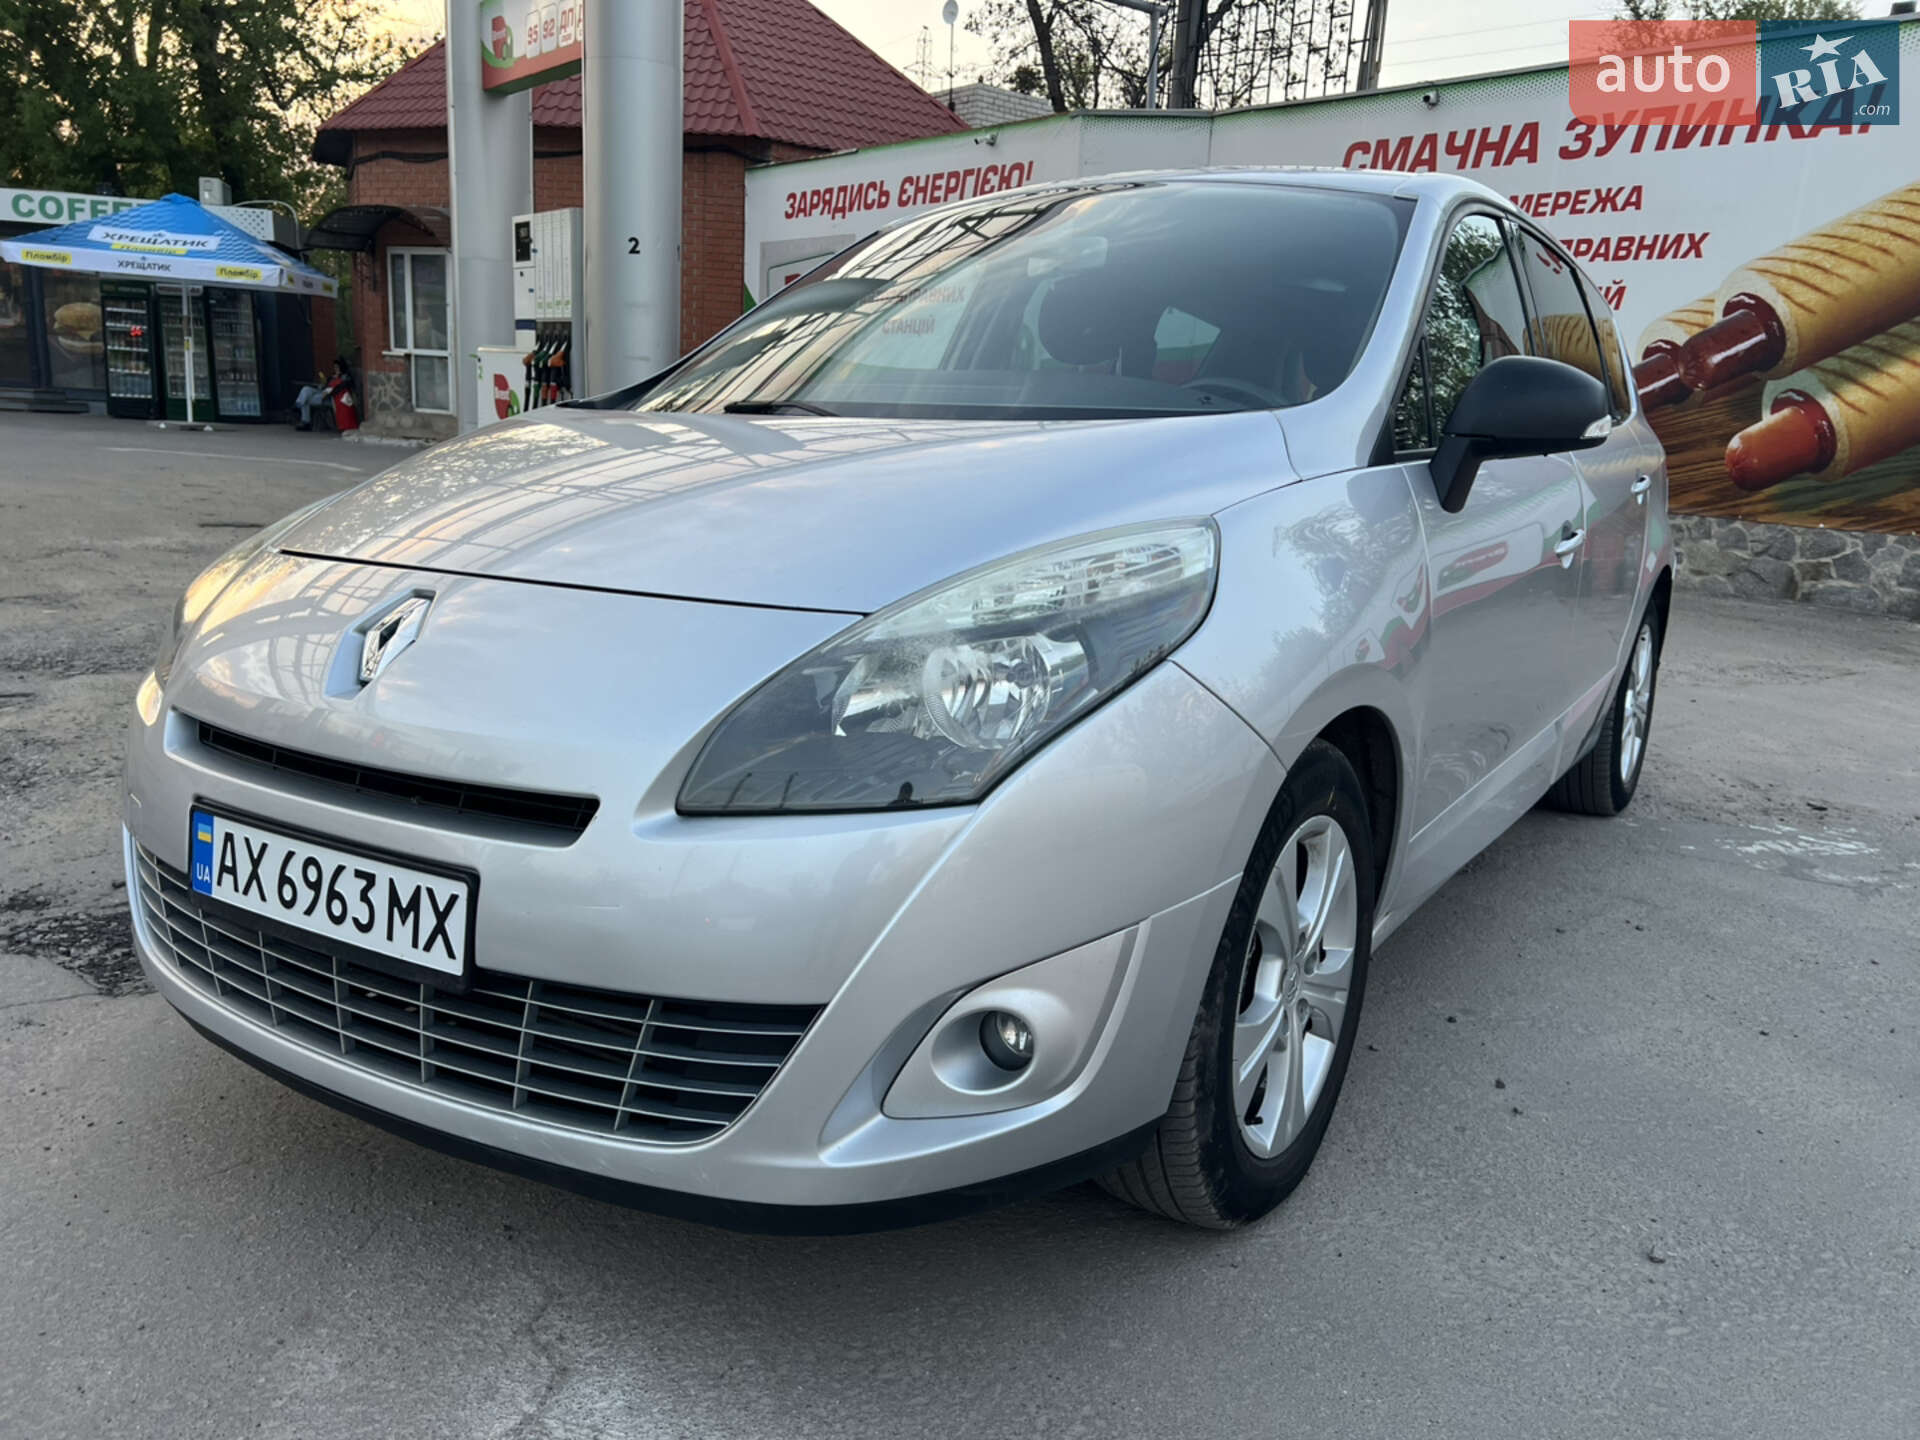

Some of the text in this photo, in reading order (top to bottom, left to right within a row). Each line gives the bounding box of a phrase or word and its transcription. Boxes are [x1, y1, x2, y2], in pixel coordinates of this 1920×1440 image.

[1342, 83, 1887, 173] СМАЧНА ЗУПИНКА!
[784, 179, 891, 220] ЗАРЯДИСЬ
[103, 231, 208, 248] ХРЕЩАТИК
[628, 237, 640, 254] 2
[117, 259, 172, 272] ХРЕЩАТИК
[219, 266, 259, 279] Пломбір
[196, 861, 211, 885] UA
